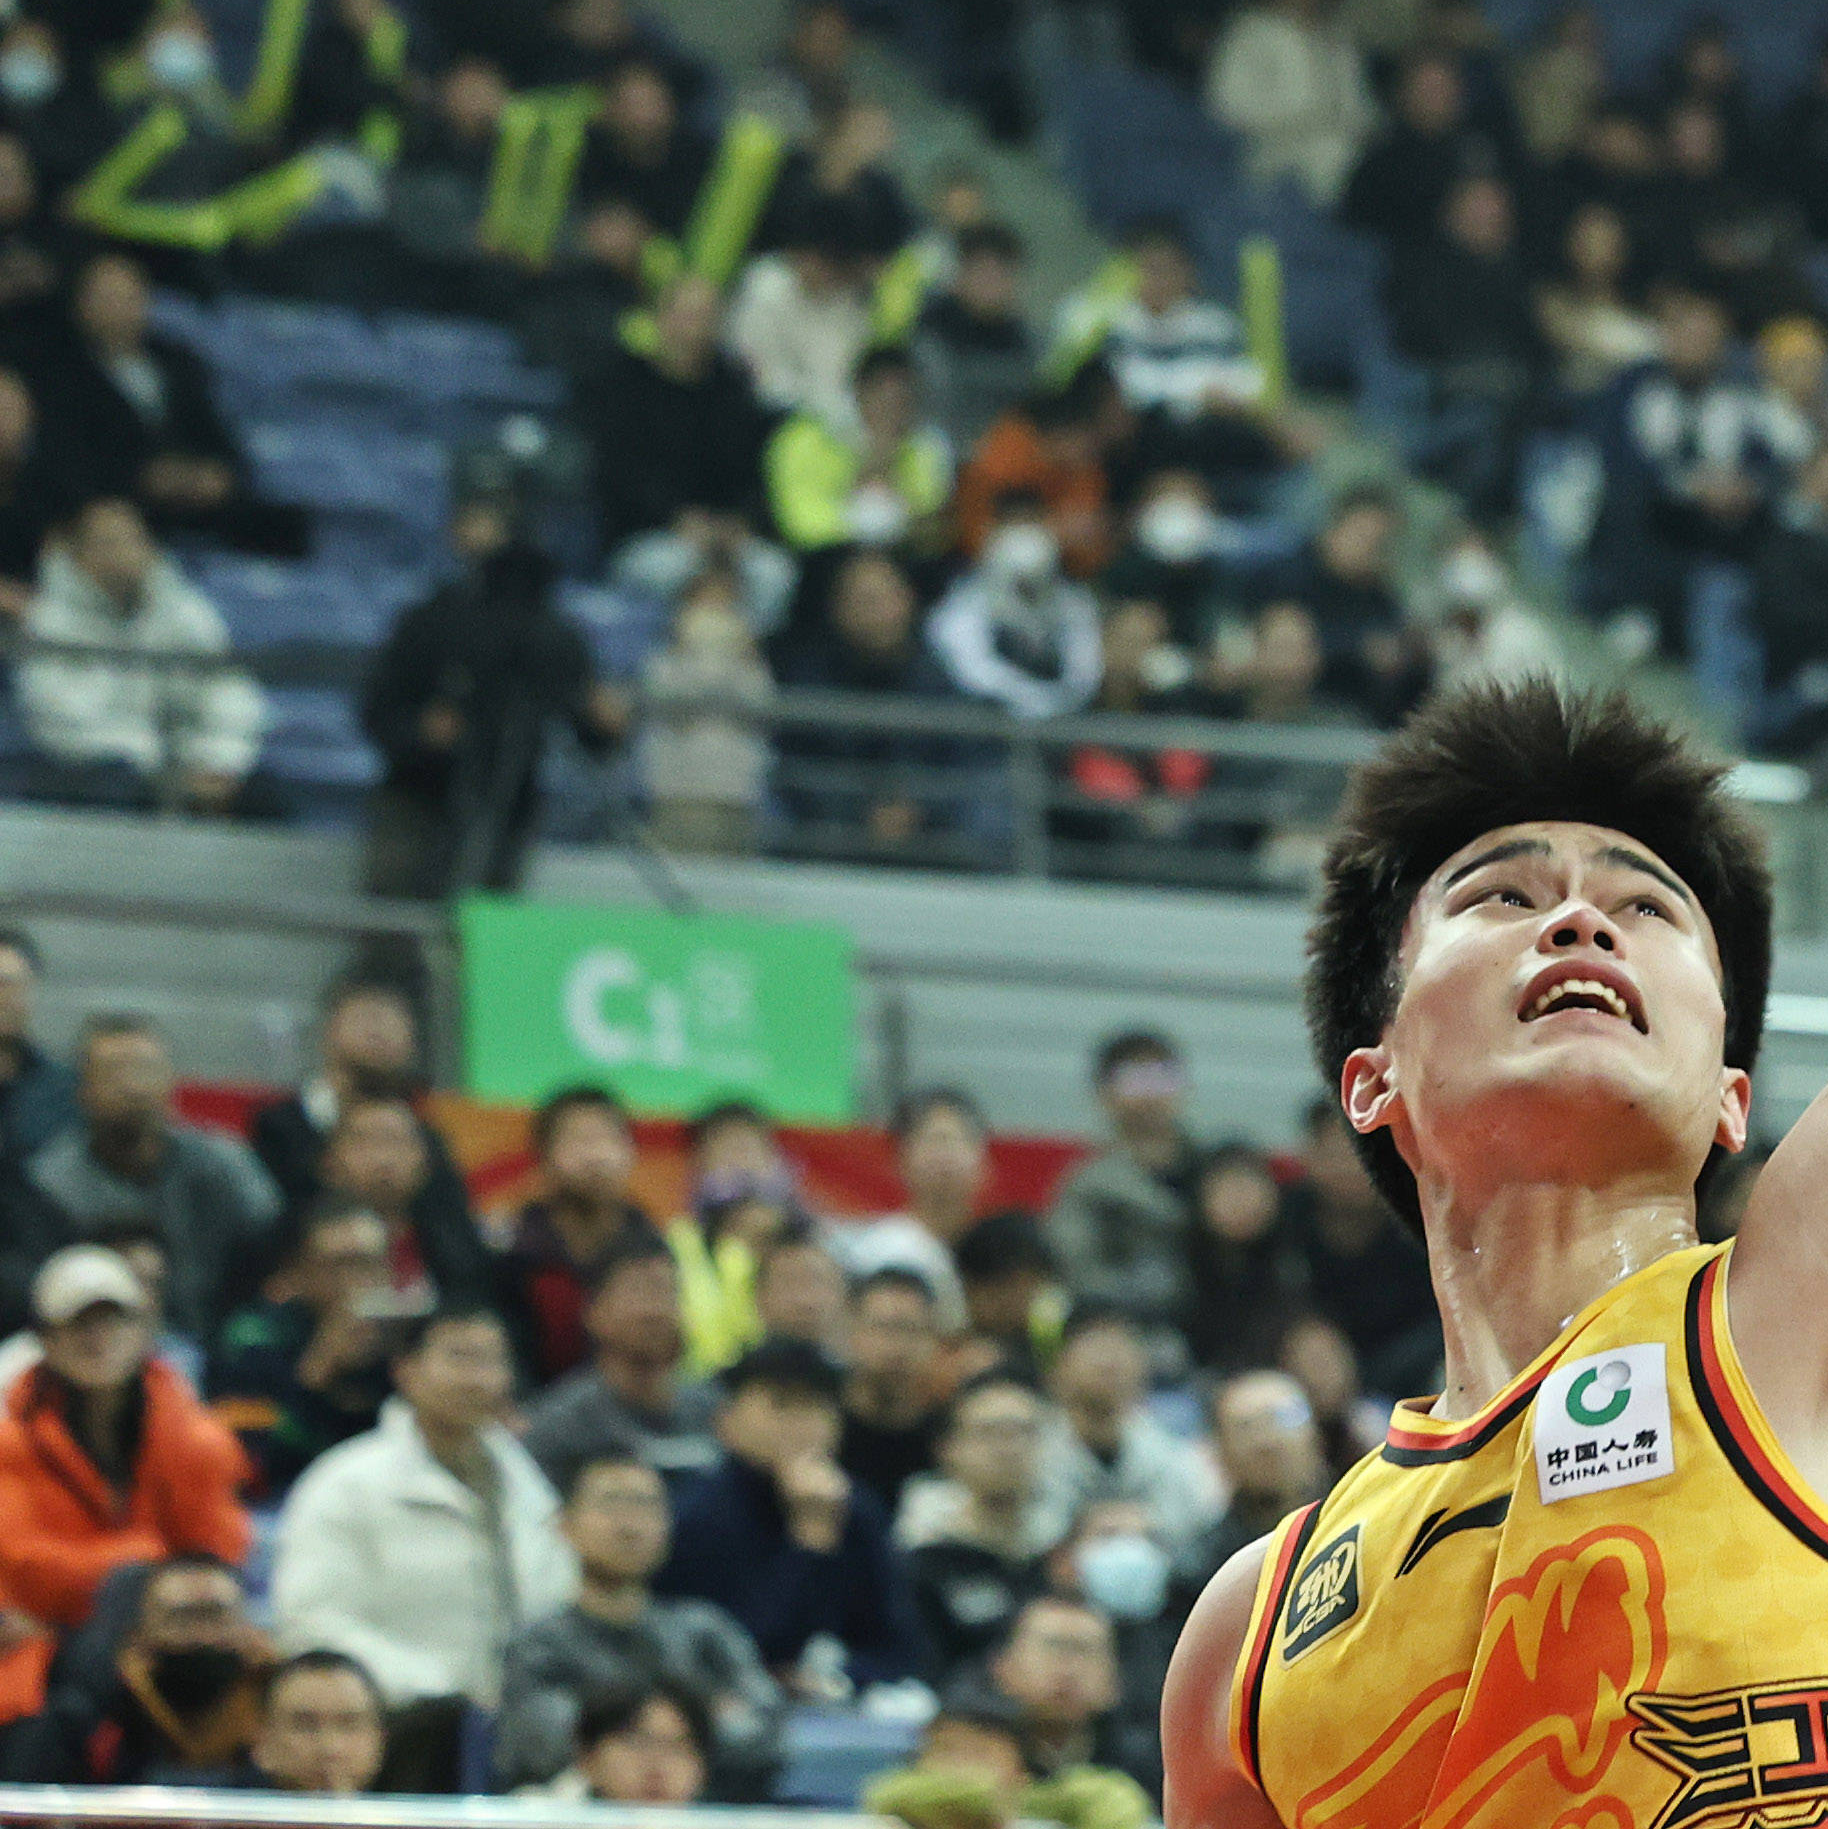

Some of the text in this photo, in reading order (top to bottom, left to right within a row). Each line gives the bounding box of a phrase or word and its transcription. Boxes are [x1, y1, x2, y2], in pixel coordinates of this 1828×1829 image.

[1547, 1428, 1658, 1469] 中国人寿
[1549, 1451, 1658, 1486] CHINA LIFE
